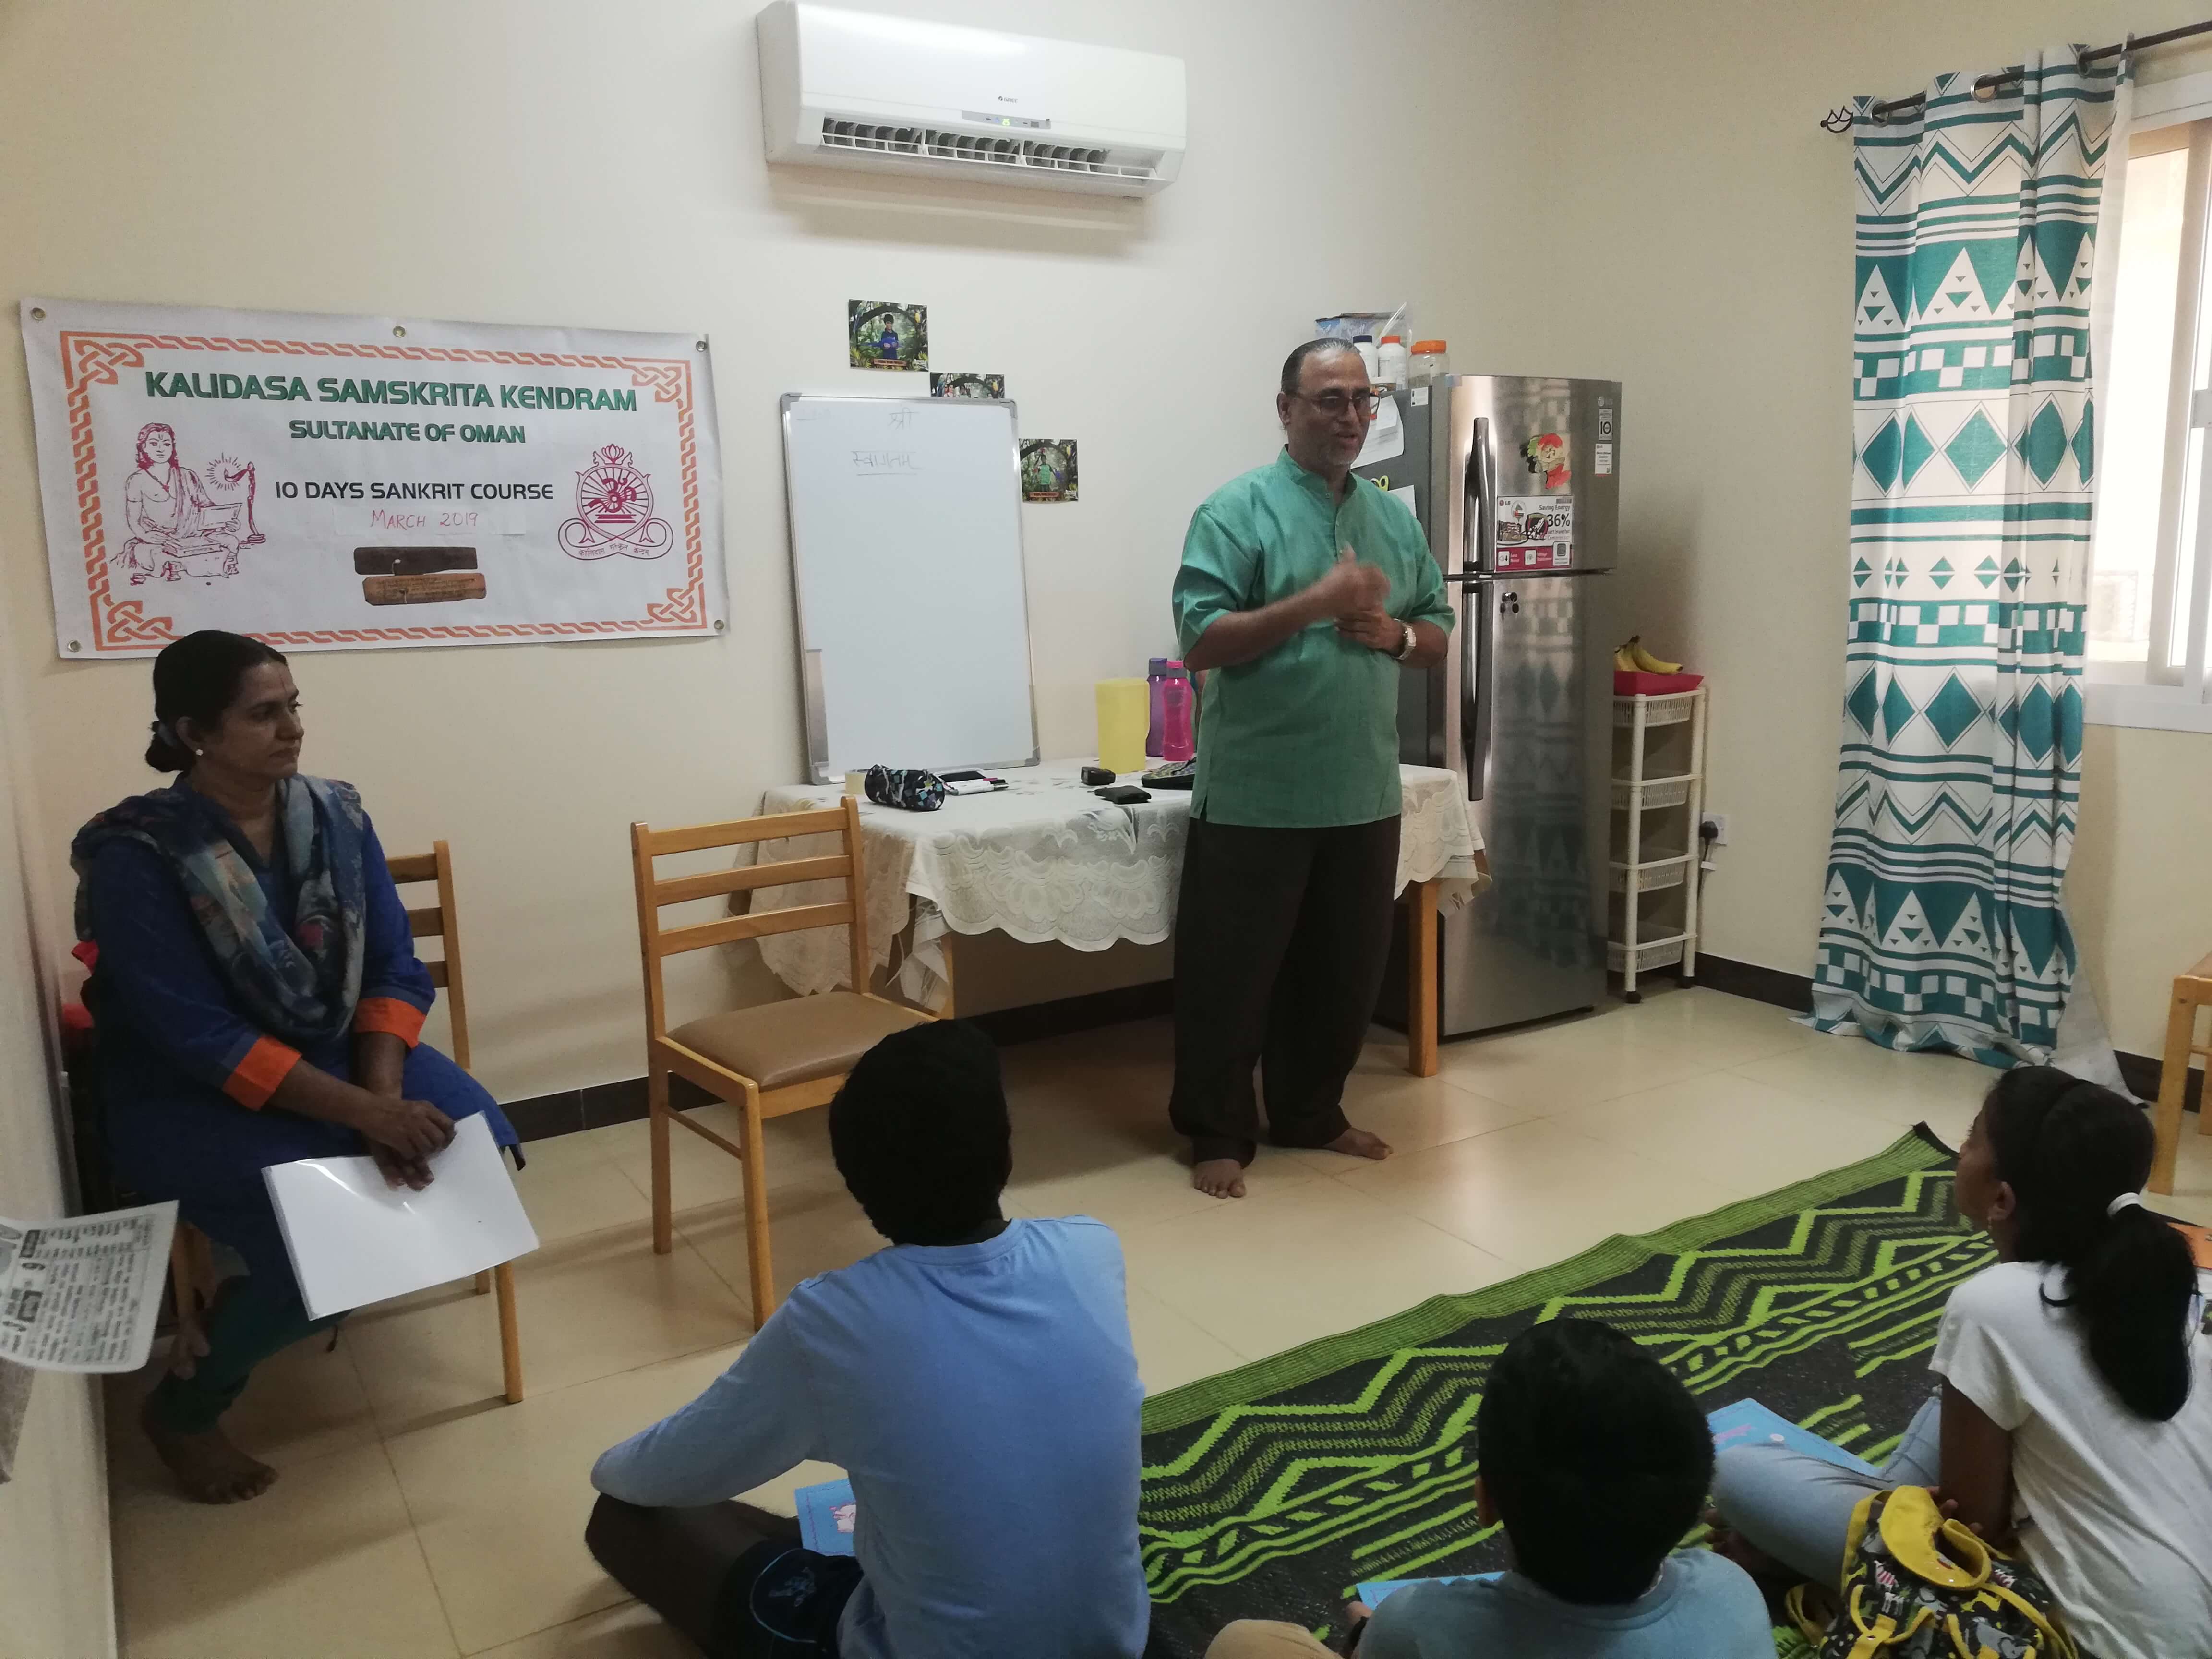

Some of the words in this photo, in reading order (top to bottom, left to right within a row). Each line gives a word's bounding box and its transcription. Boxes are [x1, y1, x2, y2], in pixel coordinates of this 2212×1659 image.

[145, 371, 312, 402] KALIDASA
[317, 378, 495, 408] SAMSKRITA
[500, 385, 637, 411] KENDRAM
[289, 420, 421, 441] SULTANATE
[425, 423, 455, 442] OF
[459, 424, 526, 443] OMAN
[1600, 421, 1611, 434] 10
[275, 481, 299, 499] 10
[304, 481, 365, 499] DAYS
[371, 482, 465, 500] SANKRIT
[470, 483, 554, 500] COURSE
[370, 509, 427, 530] MARCH
[439, 512, 479, 527] 2019
[1547, 513, 1571, 527] 36%
